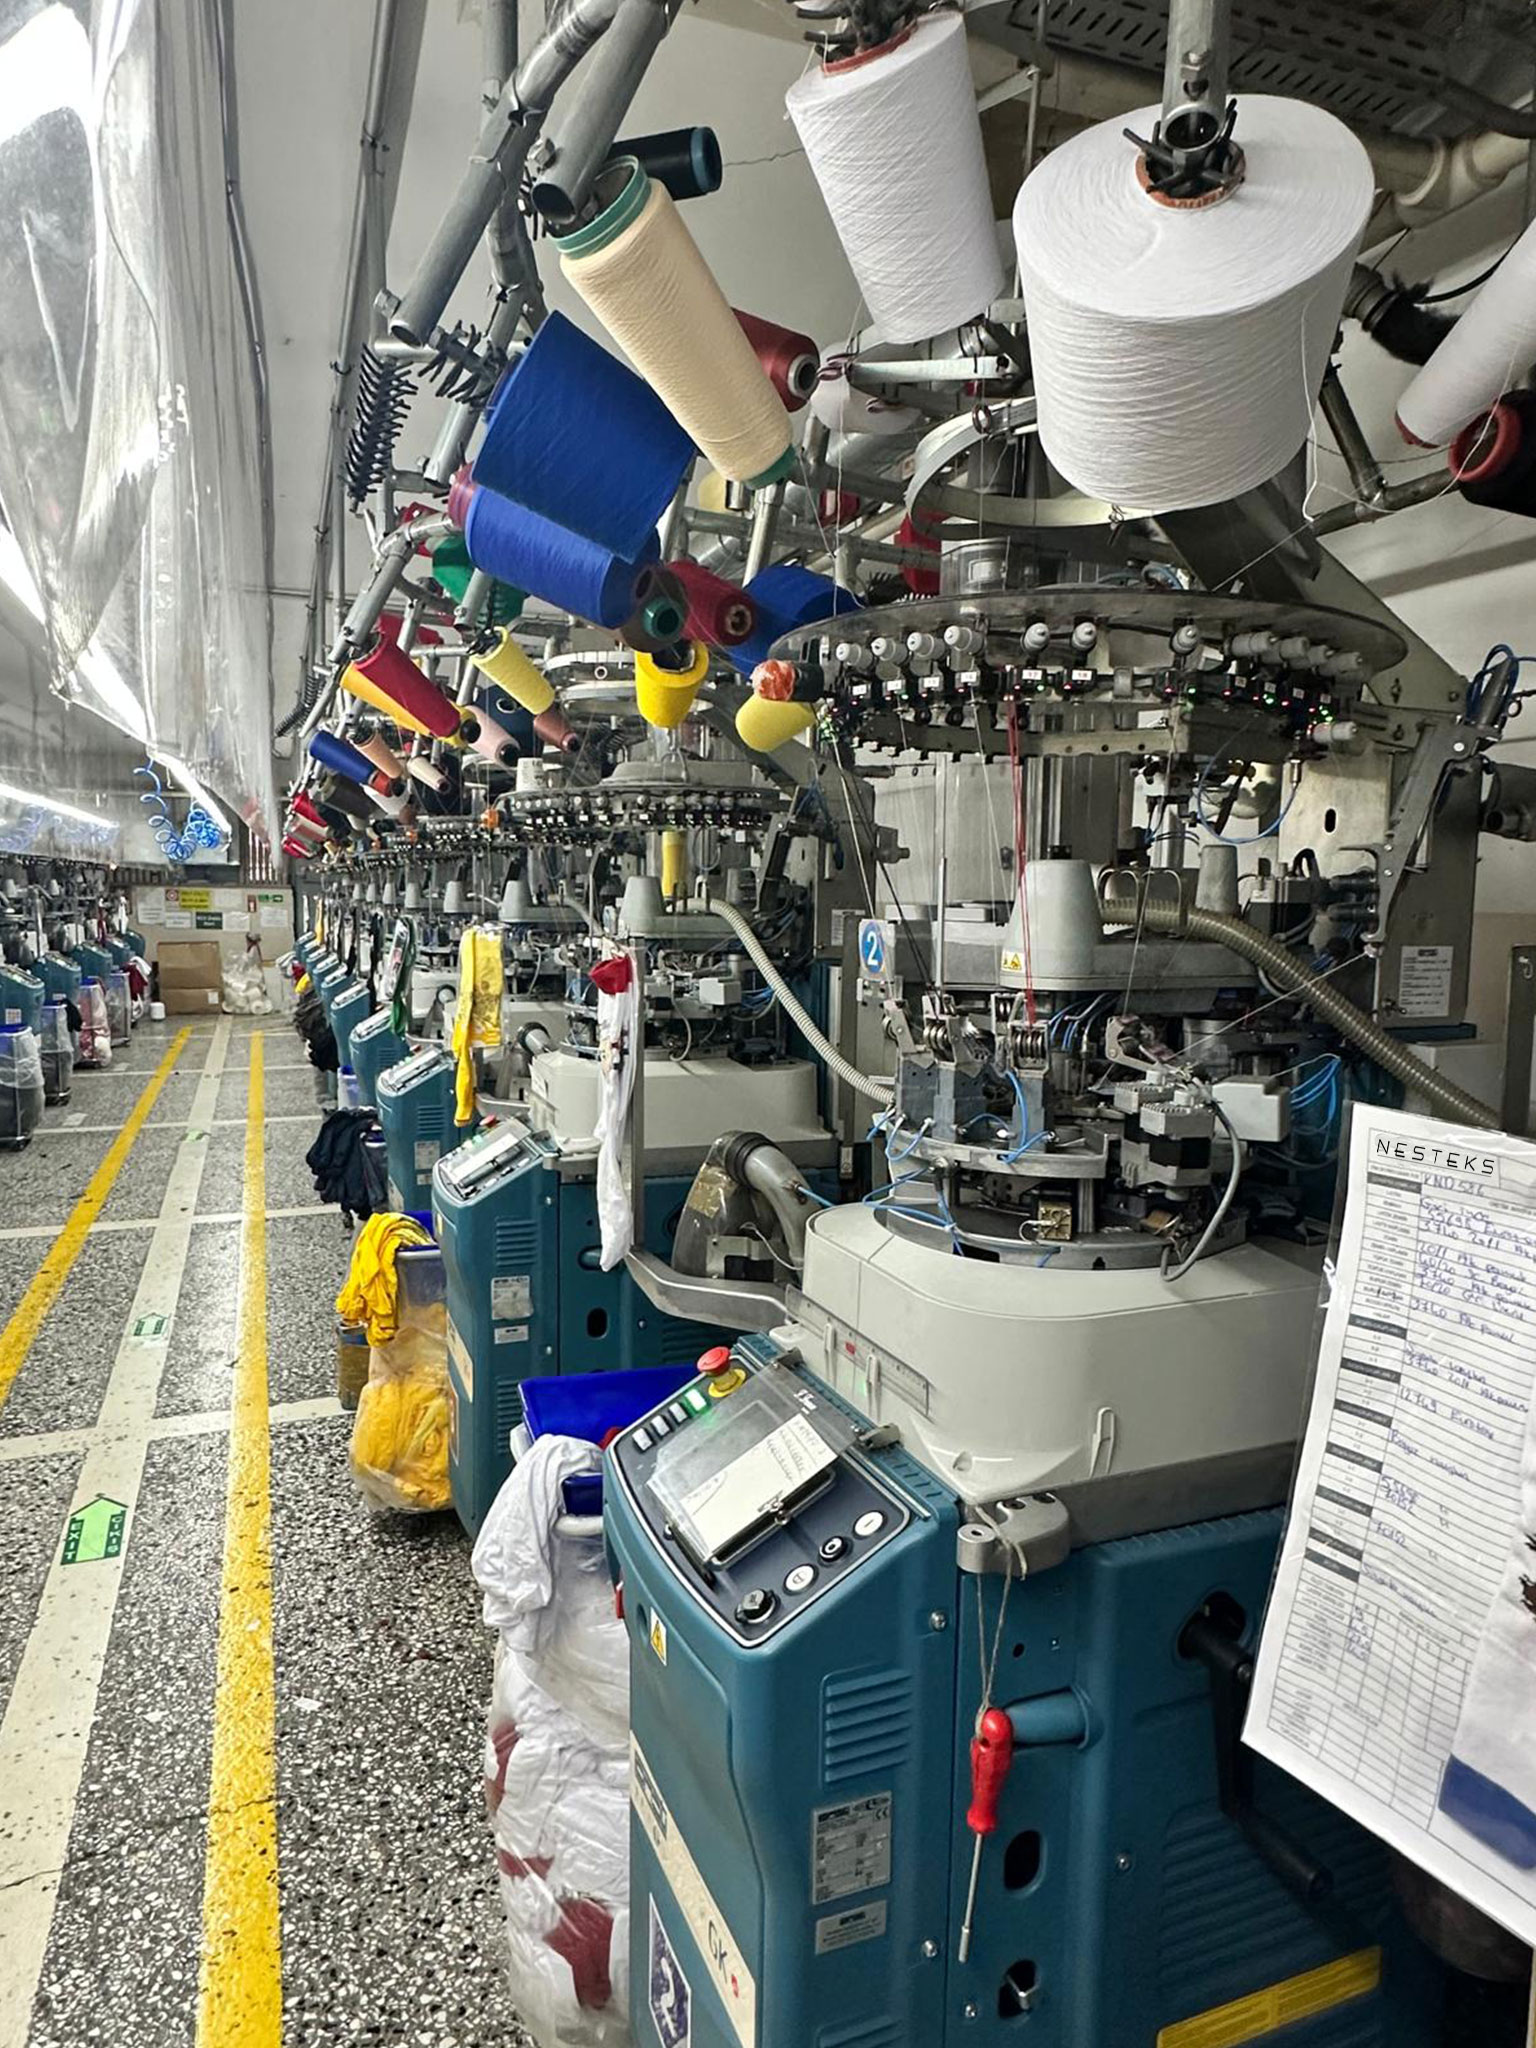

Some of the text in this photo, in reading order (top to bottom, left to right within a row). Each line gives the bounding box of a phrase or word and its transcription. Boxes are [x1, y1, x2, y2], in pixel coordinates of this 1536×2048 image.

[866, 930, 878, 966] 2
[1376, 1138, 1495, 1175] NESTEKS
[65, 1522, 81, 1560] EXIT
